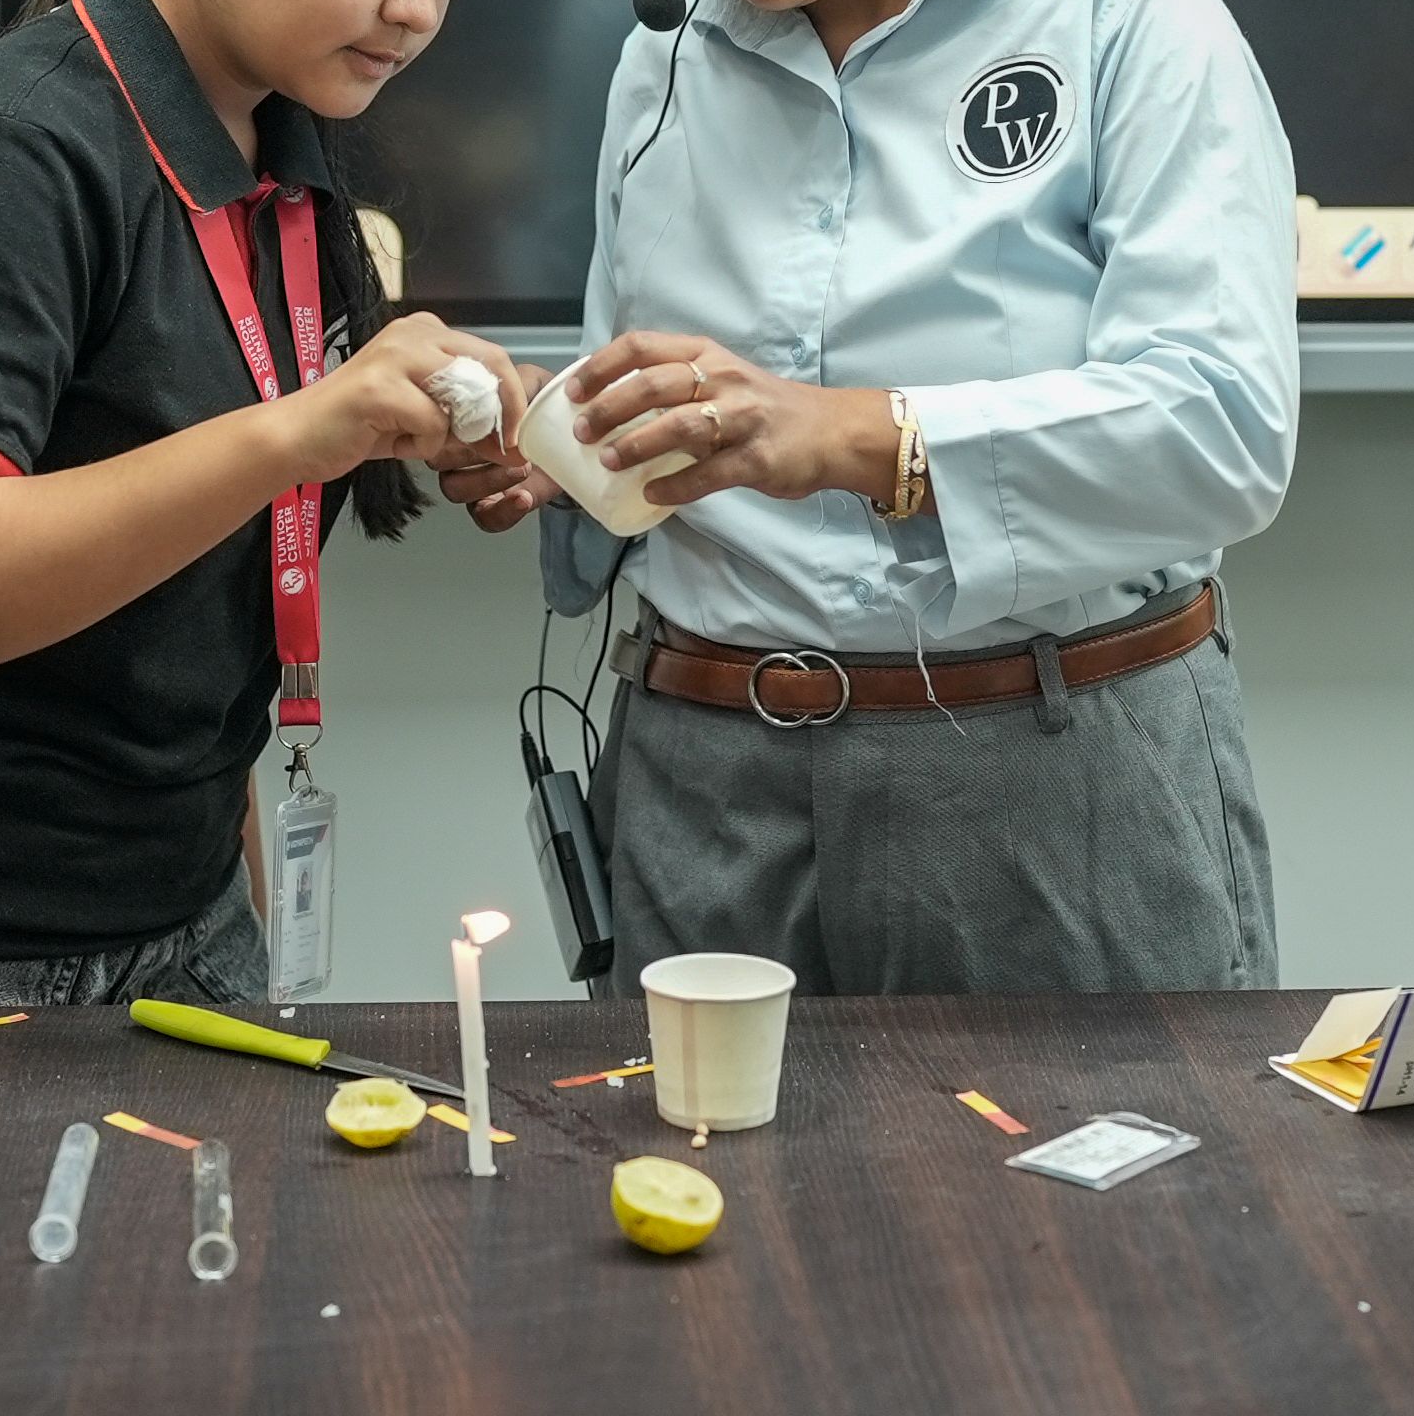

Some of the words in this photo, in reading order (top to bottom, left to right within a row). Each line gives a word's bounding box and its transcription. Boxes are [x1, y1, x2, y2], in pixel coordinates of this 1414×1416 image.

[981, 82, 1049, 165] PW
[238, 318, 263, 376] TUITION
[244, 315, 269, 372] CENTER
[294, 306, 310, 362] TUITION
[303, 306, 318, 363] CENTER
[276, 508, 288, 567] TUITION
[284, 505, 298, 563] CENTER
